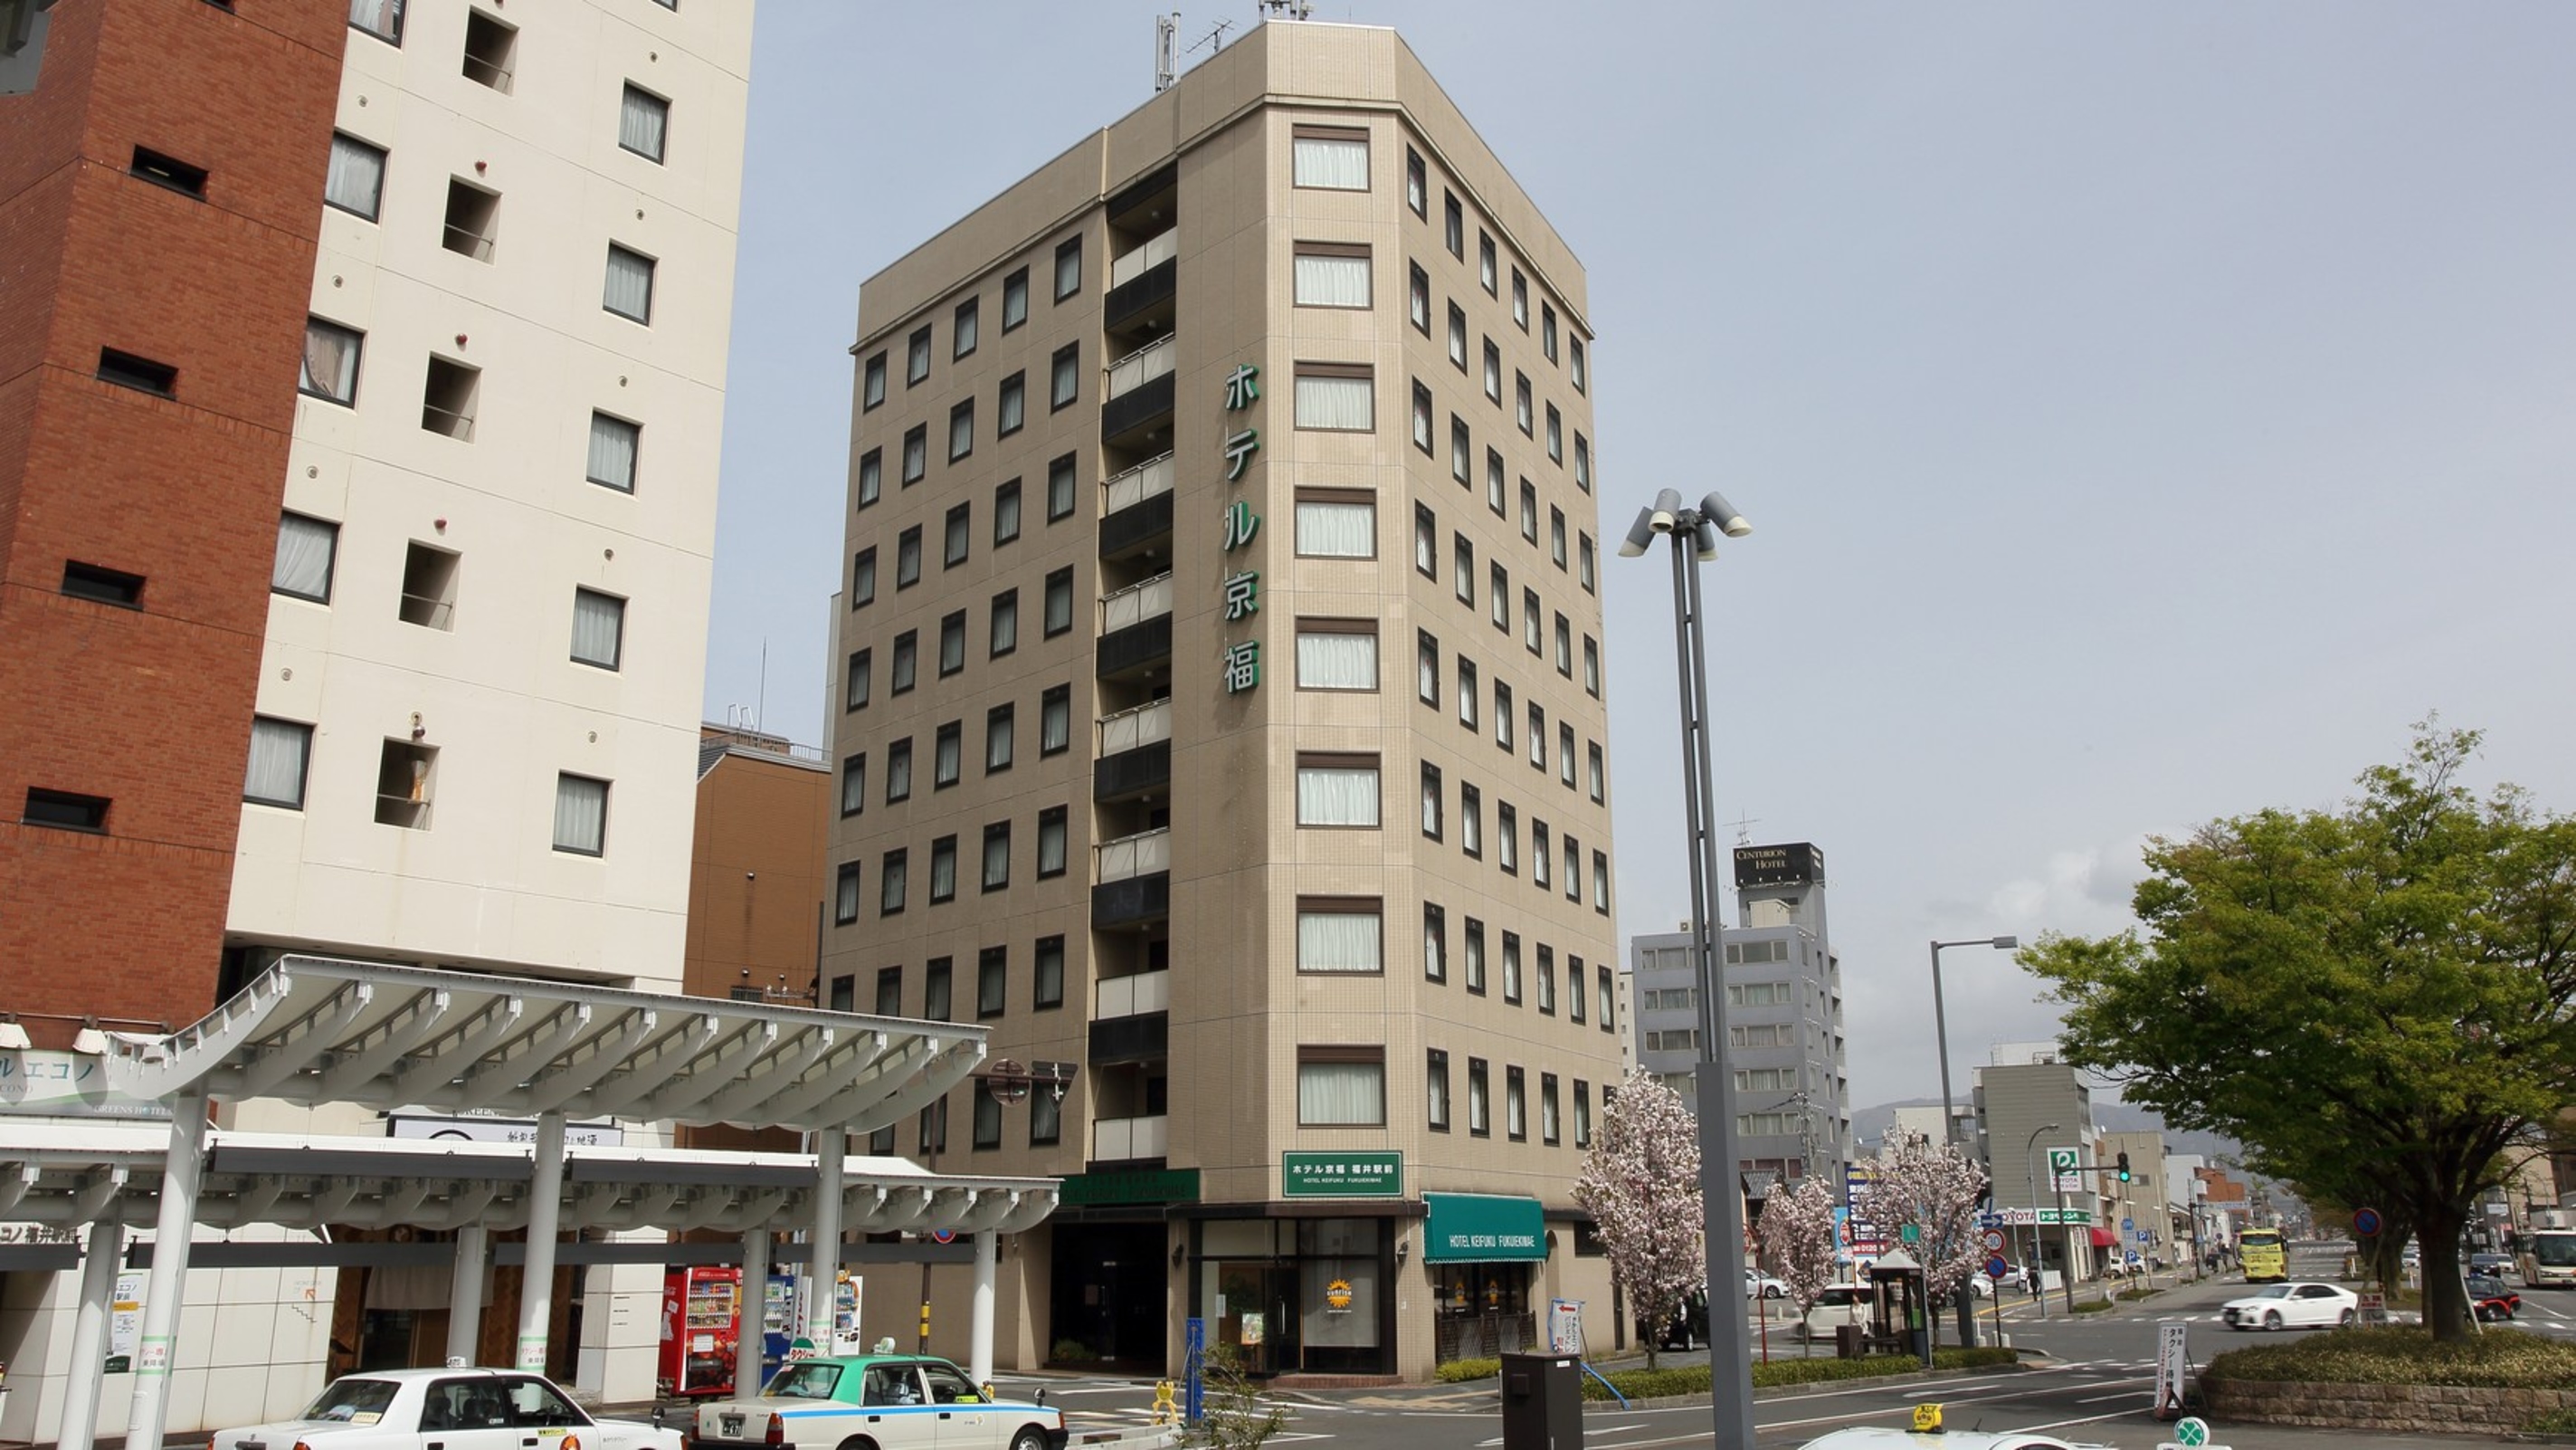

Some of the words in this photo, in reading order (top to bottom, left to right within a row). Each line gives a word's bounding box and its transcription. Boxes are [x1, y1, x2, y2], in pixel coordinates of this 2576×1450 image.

[1224, 364, 1259, 694] ホテル京福
[1736, 849, 1787, 860] CENTURION
[1755, 859, 1787, 869] HOTEL
[1292, 1164, 1345, 1175] ホテル京福
[1352, 1164, 1393, 1175] 福井駅前
[1995, 1213, 2035, 1222] OYOTA
[1449, 1235, 1470, 1247] HOTEL
[1470, 1235, 1496, 1247] KEIFUKU
[1498, 1235, 1535, 1247] FUKUIEKIMAE
